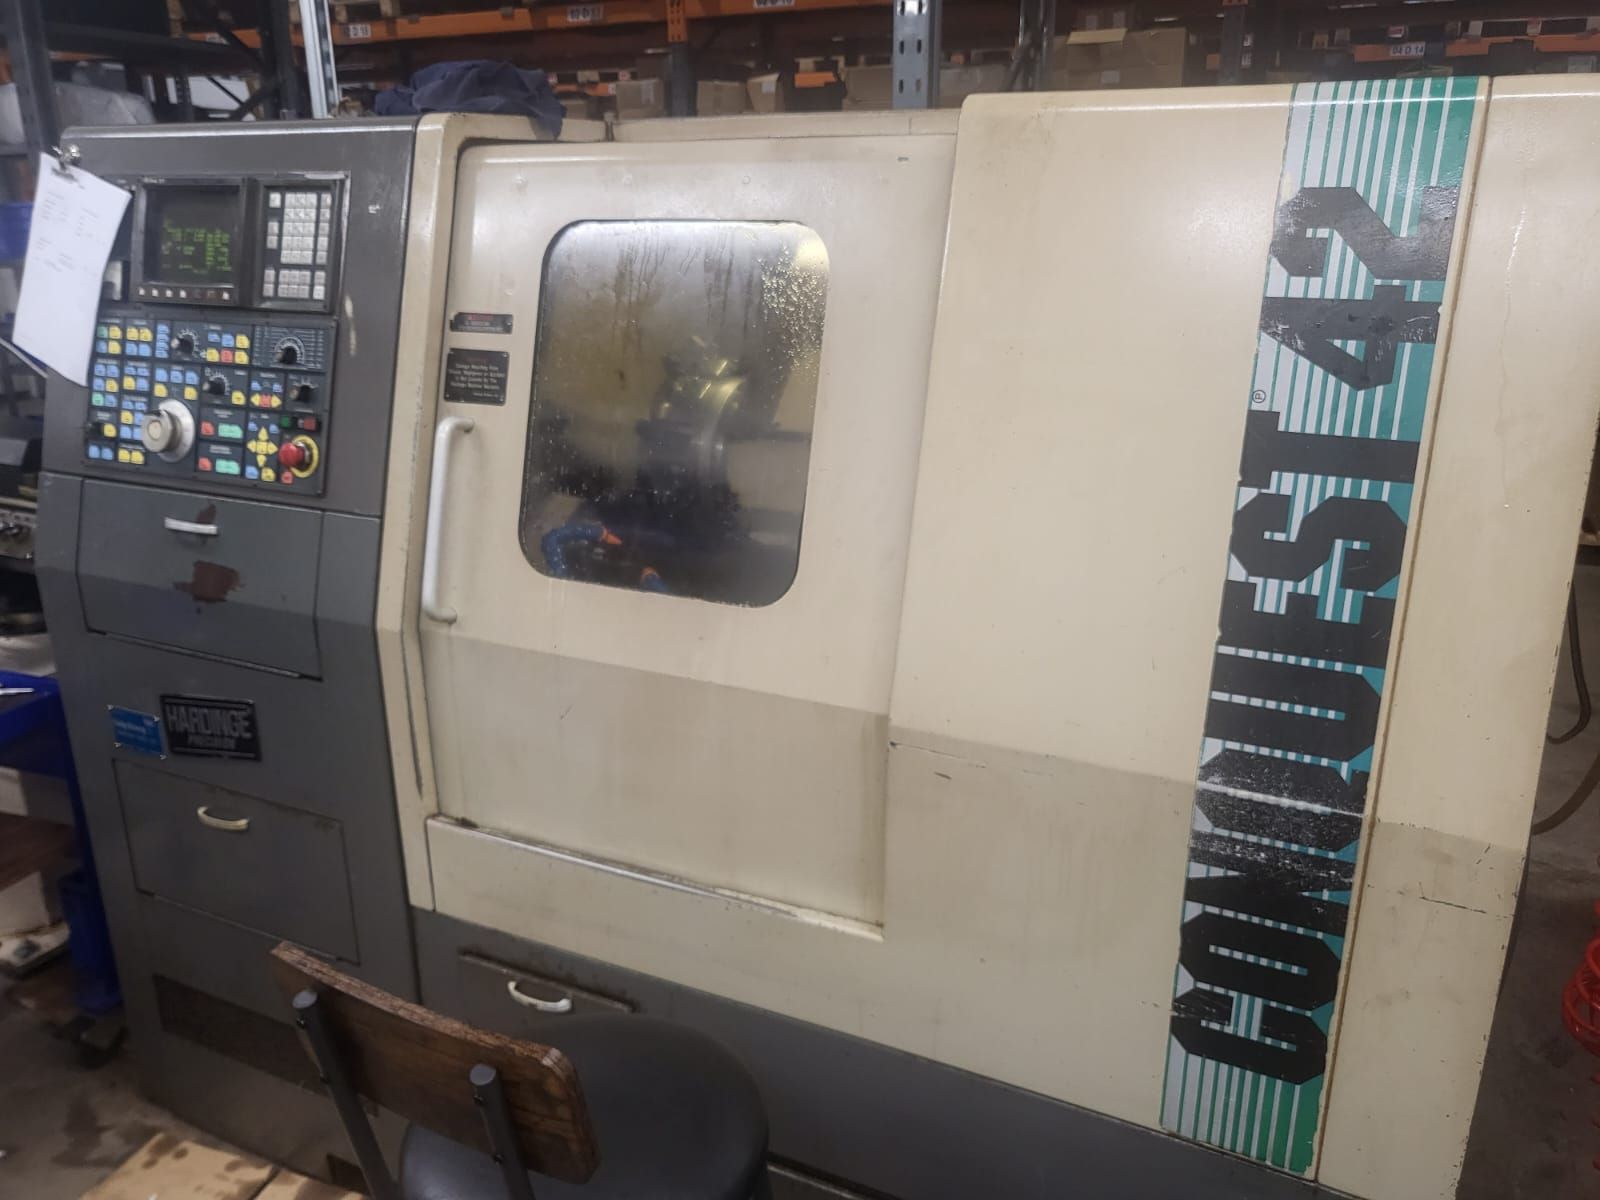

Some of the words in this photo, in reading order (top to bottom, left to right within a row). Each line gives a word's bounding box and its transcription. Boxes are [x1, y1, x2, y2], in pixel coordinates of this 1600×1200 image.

[1260, 187, 1458, 391] 42
[166, 704, 252, 738] HARDINGE
[1170, 410, 1420, 1084] CONQUEST
